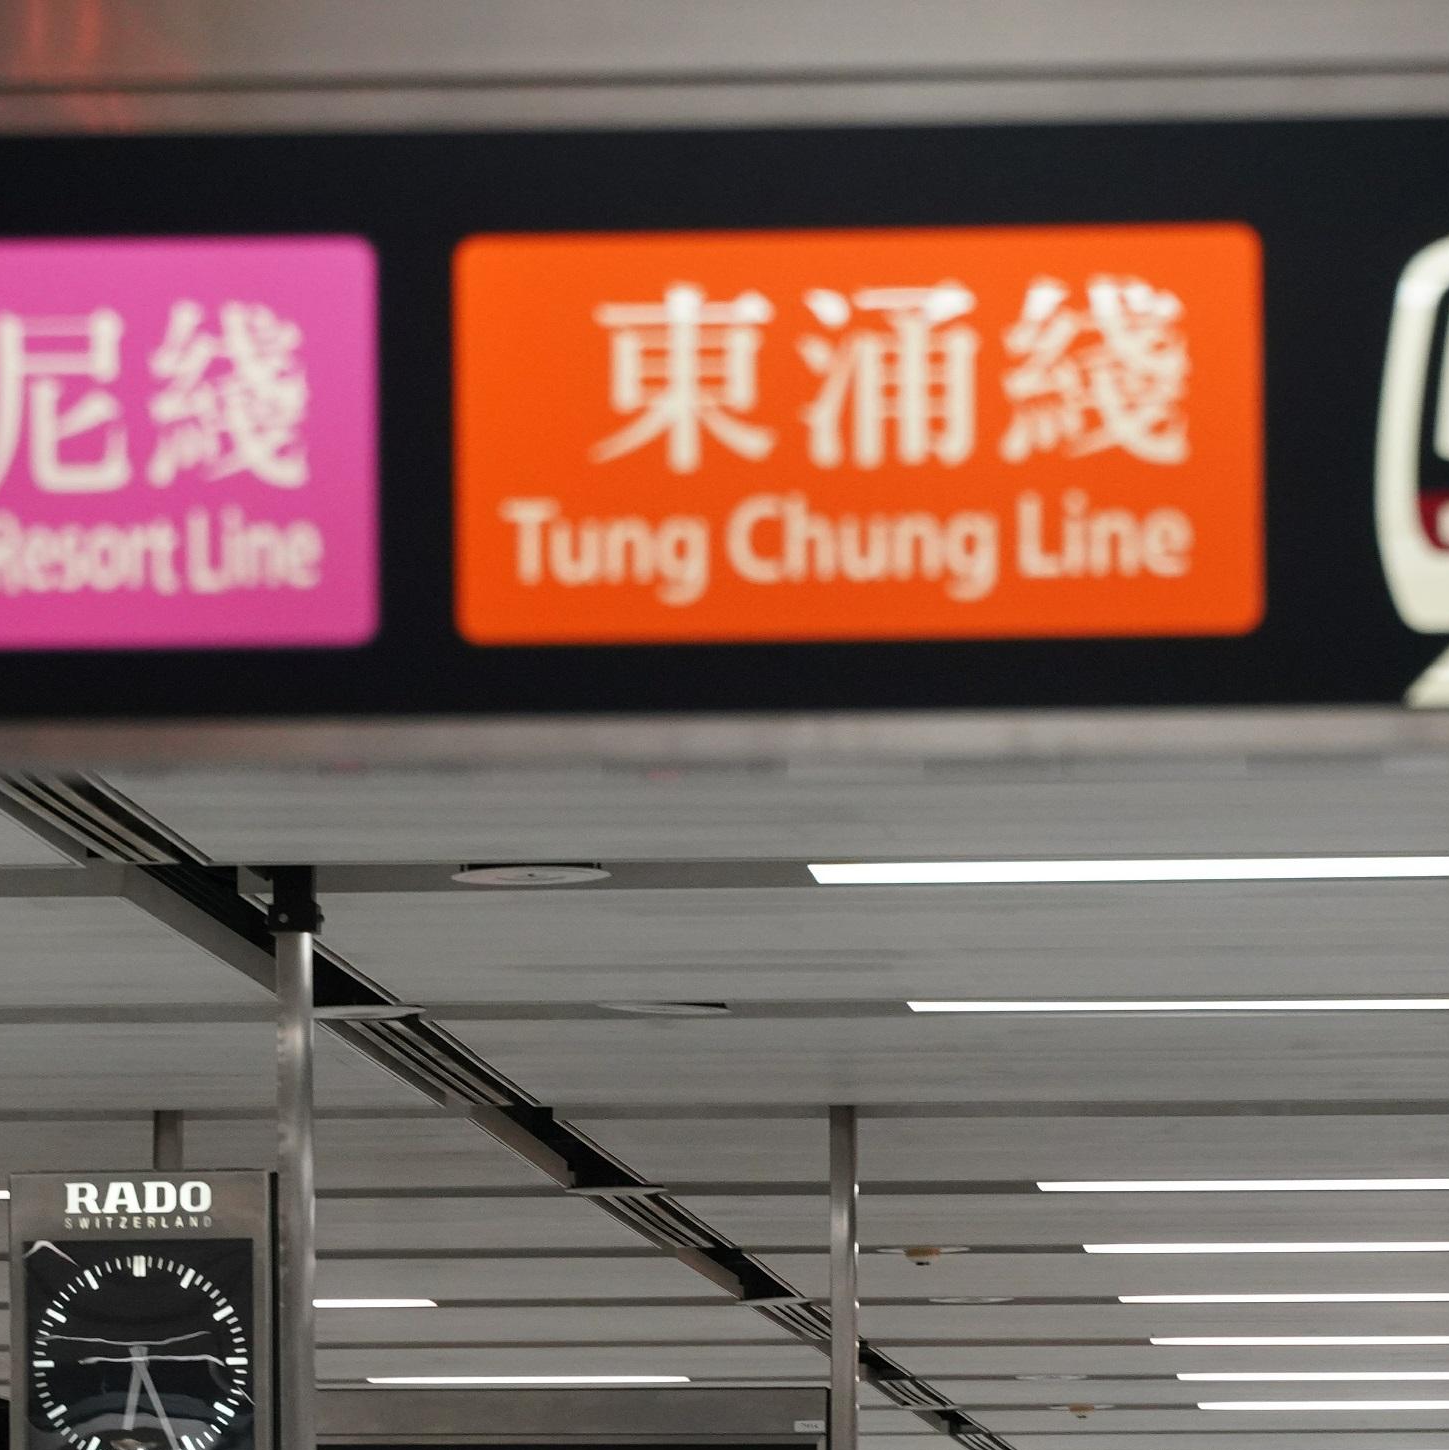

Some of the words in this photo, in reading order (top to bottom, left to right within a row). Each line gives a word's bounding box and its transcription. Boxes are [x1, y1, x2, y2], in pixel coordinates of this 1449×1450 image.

[588, 272, 1190, 472] 東涌綫
[184, 508, 322, 595] Line
[500, 497, 710, 605] Tung
[726, 492, 999, 602] Chung
[1018, 490, 1193, 579] Line
[64, 1181, 212, 1214] RADO
[64, 1216, 212, 1229] SWITZERLAND
